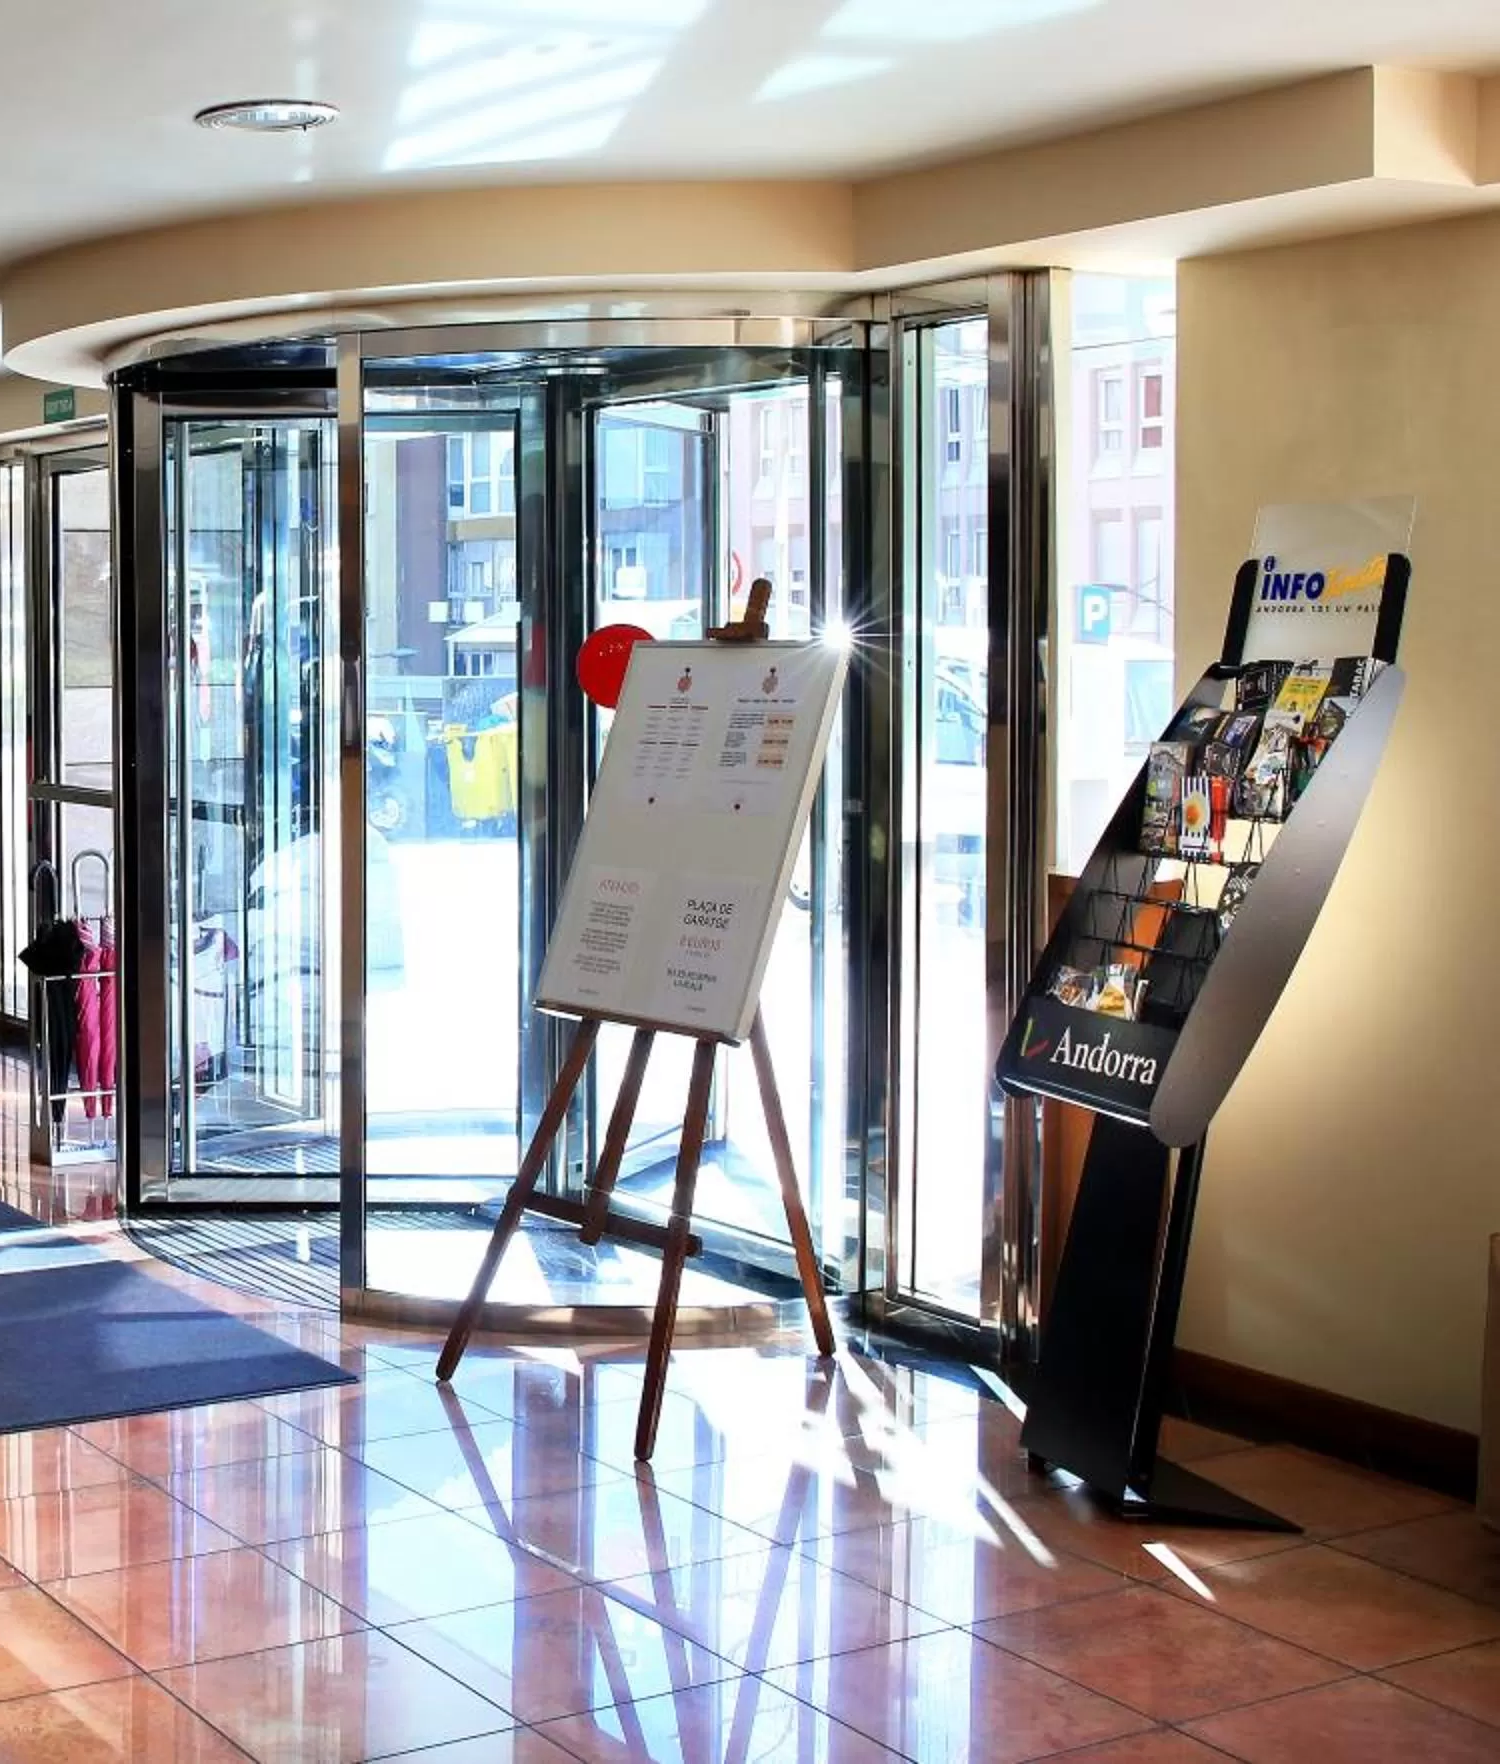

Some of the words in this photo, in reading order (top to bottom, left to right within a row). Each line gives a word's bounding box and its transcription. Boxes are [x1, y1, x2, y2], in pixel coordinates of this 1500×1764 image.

[1261, 571, 1325, 600] INFO
[1083, 595, 1108, 630] P
[1256, 604, 1304, 613] ANDORRA
[687, 899, 717, 914] PLAÇA
[719, 903, 735, 914] DE
[1050, 1026, 1157, 1085] Andorra
